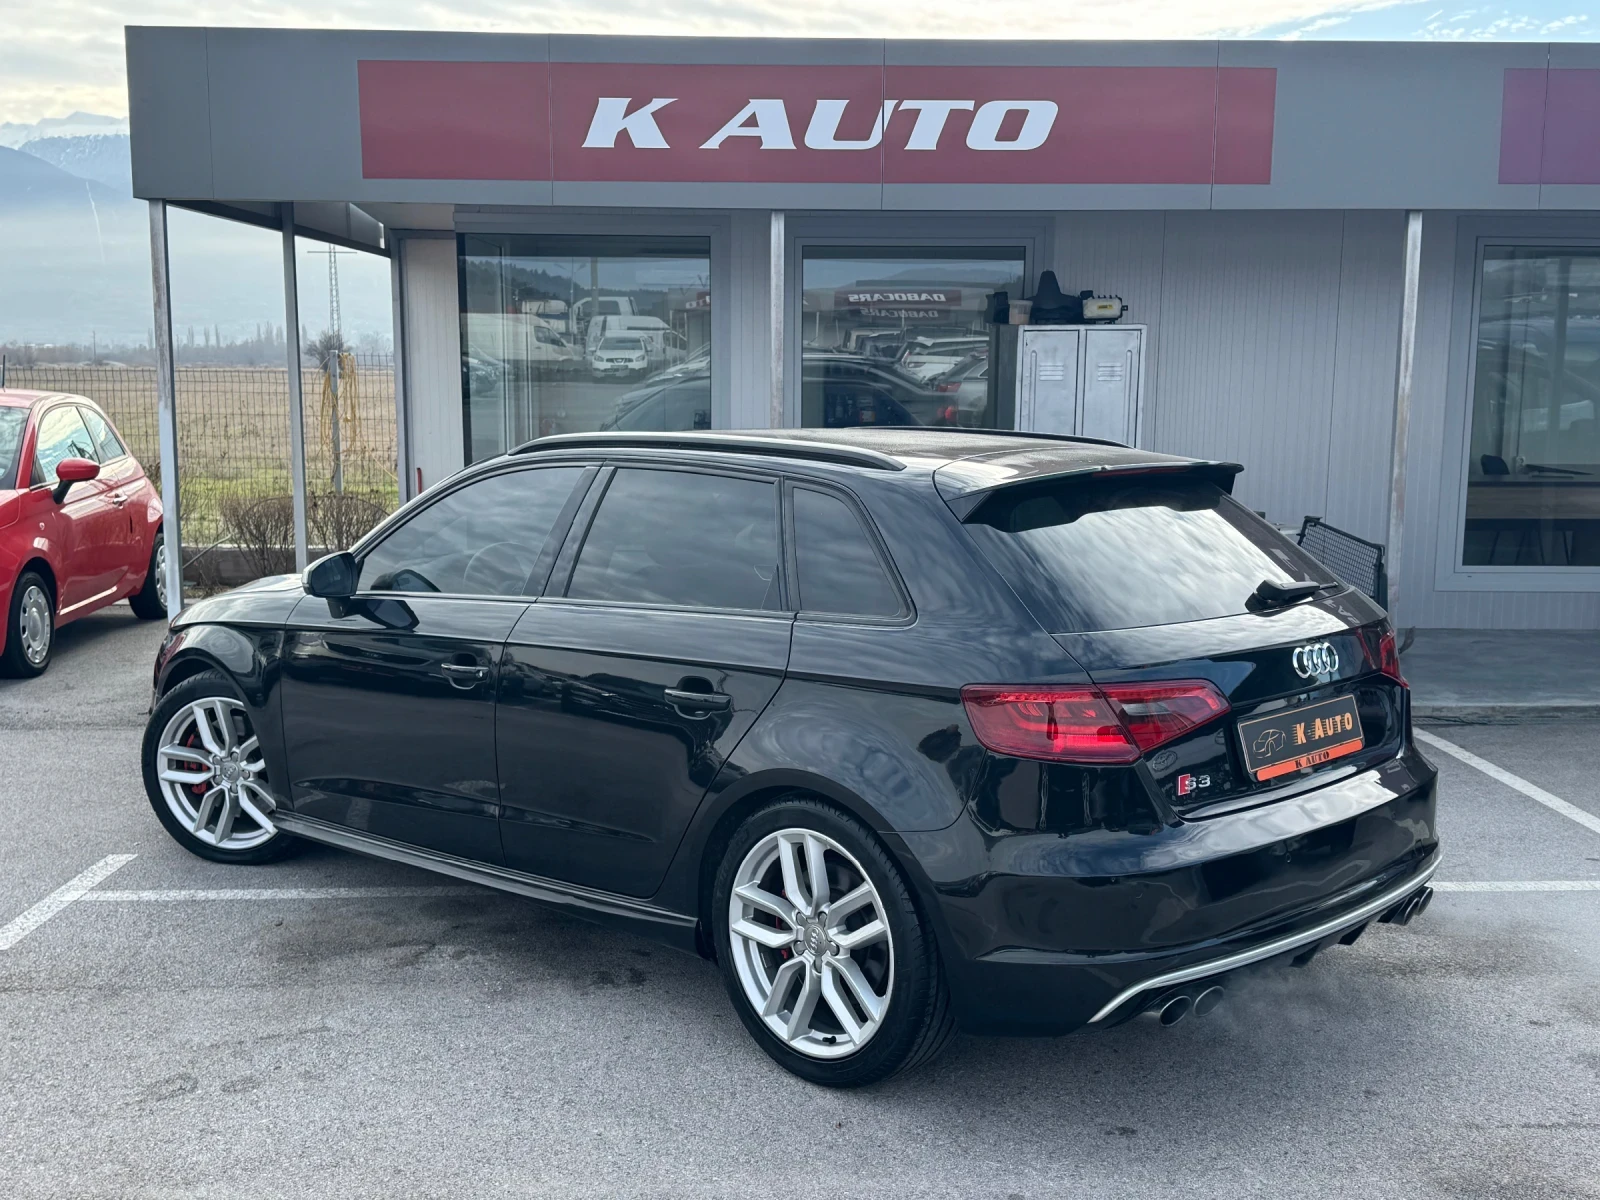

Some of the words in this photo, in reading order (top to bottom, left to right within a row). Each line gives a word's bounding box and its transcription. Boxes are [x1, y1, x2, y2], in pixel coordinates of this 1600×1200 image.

[581, 97, 679, 149] K
[698, 98, 1059, 151] AUTO
[1294, 722, 1307, 745] K
[1311, 713, 1353, 740] AUTO
[1295, 759, 1303, 769] K
[1305, 751, 1330, 766] AUTO
[1184, 774, 1211, 791] S3
